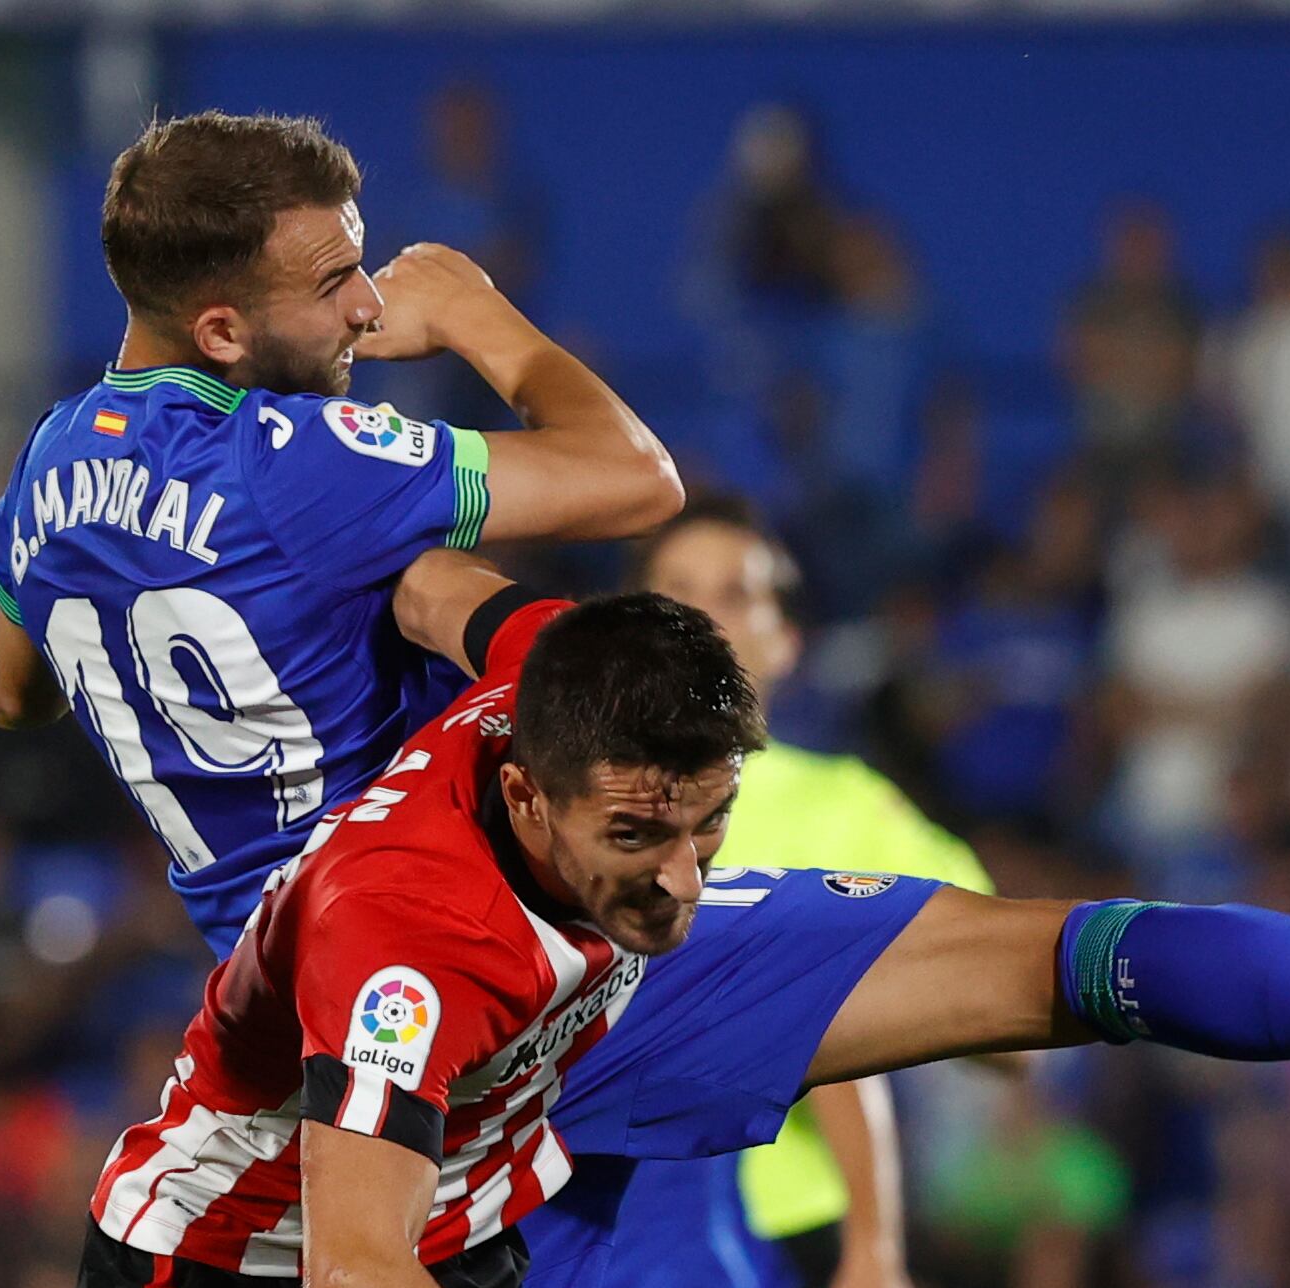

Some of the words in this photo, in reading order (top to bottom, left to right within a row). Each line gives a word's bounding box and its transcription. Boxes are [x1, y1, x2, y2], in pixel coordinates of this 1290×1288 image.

[409, 420, 425, 459] LaLi
[43, 587, 325, 874] 19
[350, 1045, 415, 1076] LaLiga
[497, 954, 648, 1084] Kutxaba
